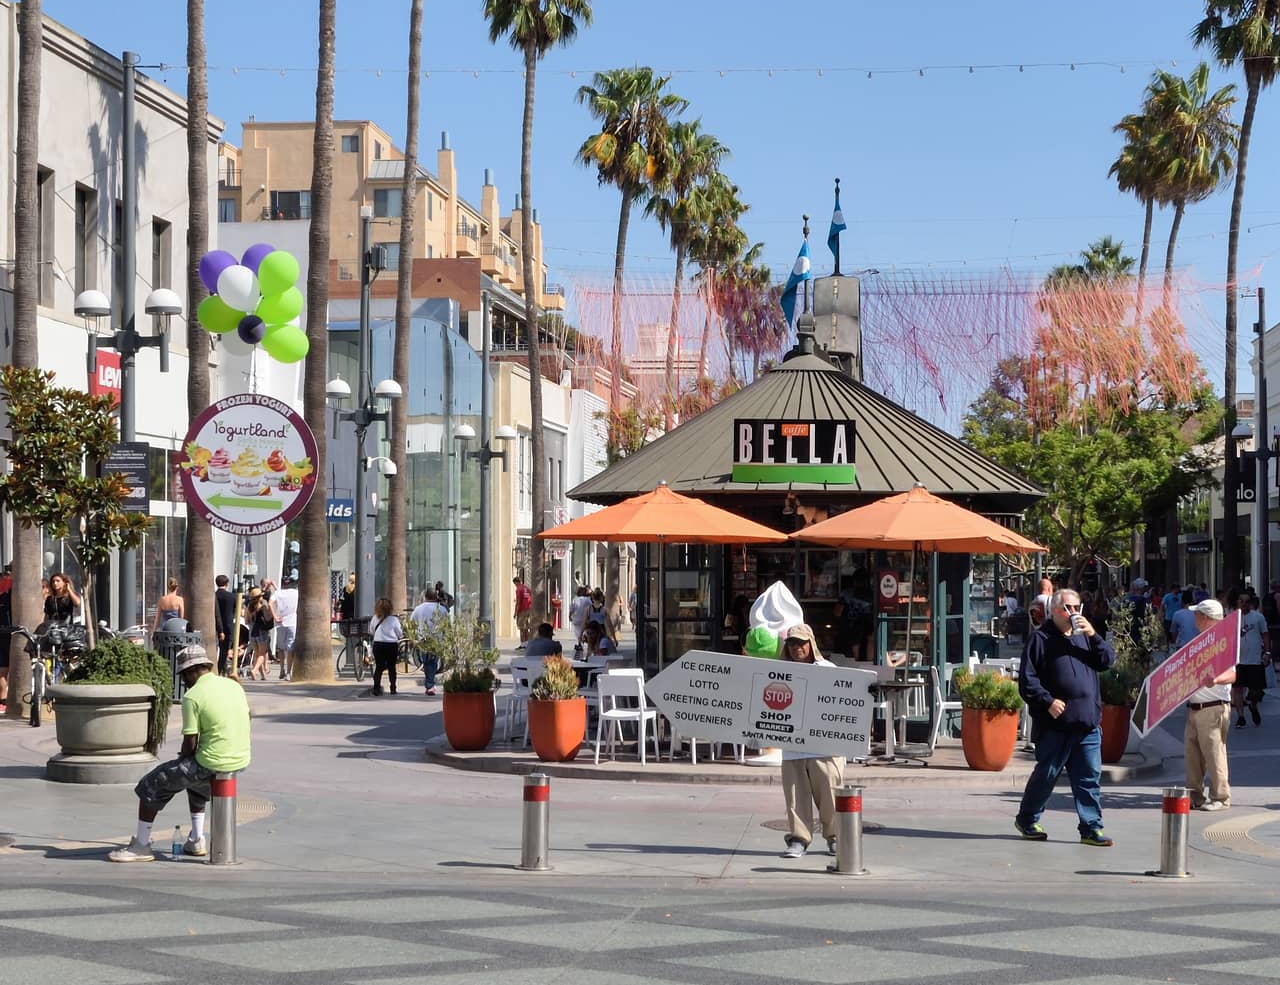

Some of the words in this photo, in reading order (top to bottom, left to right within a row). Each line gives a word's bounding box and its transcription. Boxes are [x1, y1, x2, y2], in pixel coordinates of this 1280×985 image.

[216, 395, 253, 412] FROZEN
[255, 395, 294, 417] YOGURT
[213, 420, 288, 442] Yogurtland
[738, 423, 848, 465] BELLA
[325, 503, 352, 517] ids
[1164, 652, 1187, 678] Planet
[1188, 631, 1216, 657] Beauty
[681, 661, 696, 671] ICE
[698, 663, 732, 675] CREAM
[1156, 668, 1183, 701] STORE
[1184, 637, 1227, 677] CLOSING
[768, 671, 793, 682] ONE
[689, 679, 720, 691] LOTTO
[833, 679, 853, 689] ATM
[663, 692, 709, 706] GREETING
[711, 699, 743, 711] CARDS
[764, 690, 792, 703] STOP
[817, 695, 837, 705] HOT
[838, 697, 865, 708] FOOD
[674, 711, 733, 727] SOUVENIERS
[760, 711, 792, 722] SHOP
[820, 713, 858, 725] COFFEE
[759, 722, 791, 732] MARKET
[741, 730, 765, 740] SANTA
[794, 737, 806, 745] CA
[809, 728, 866, 743] BEVERAGES
